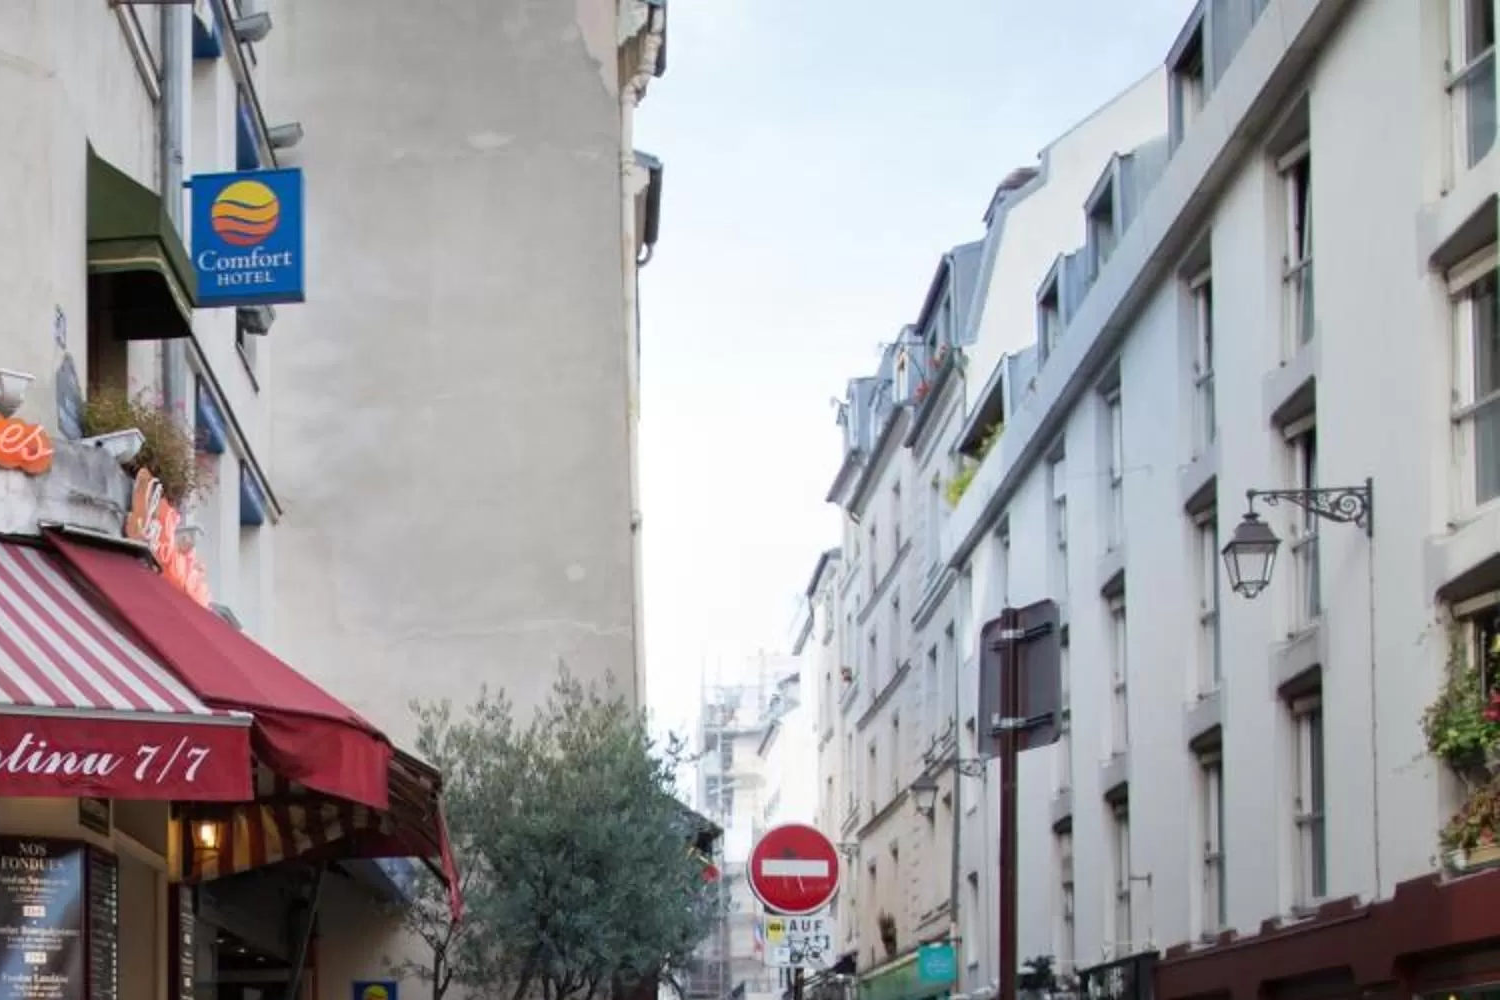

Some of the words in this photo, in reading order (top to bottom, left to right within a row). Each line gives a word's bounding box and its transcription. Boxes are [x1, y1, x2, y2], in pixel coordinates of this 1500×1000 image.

[198, 245, 293, 272] Comfort
[217, 270, 276, 288] HOTEL
[133, 736, 211, 784] 7/7
